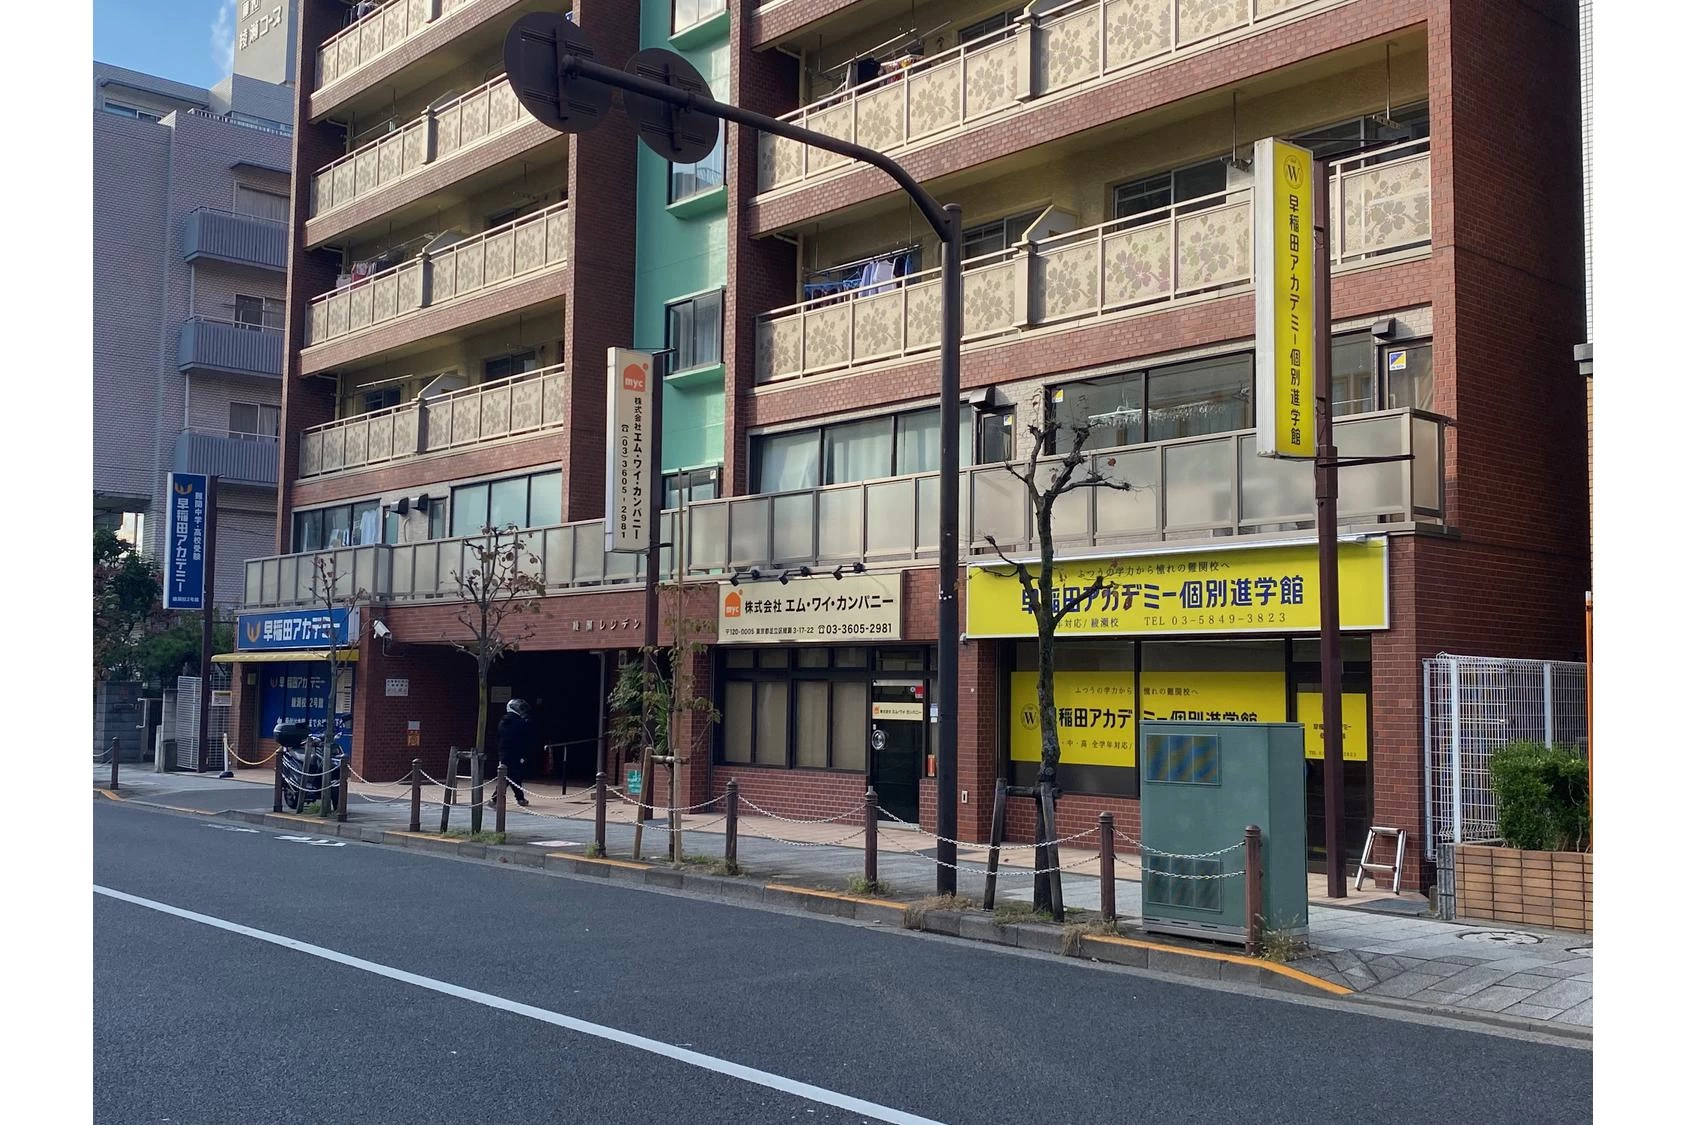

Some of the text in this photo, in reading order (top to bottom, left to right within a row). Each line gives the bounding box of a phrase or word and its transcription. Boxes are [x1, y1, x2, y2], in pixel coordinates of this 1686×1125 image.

[1289, 194, 1301, 446] 早稲田アカデミー個別進学館
[624, 377, 645, 389] myc
[175, 497, 190, 593] 早稲田アカデミー
[744, 595, 894, 614] 株式会社 エム・ワイ・カンパニー
[263, 616, 341, 642] 早稲田アカデミー
[1144, 616, 1166, 627] TEL
[1171, 612, 1287, 626] 03-5849-3823
[1055, 707, 1133, 729] 稲田アカデ
